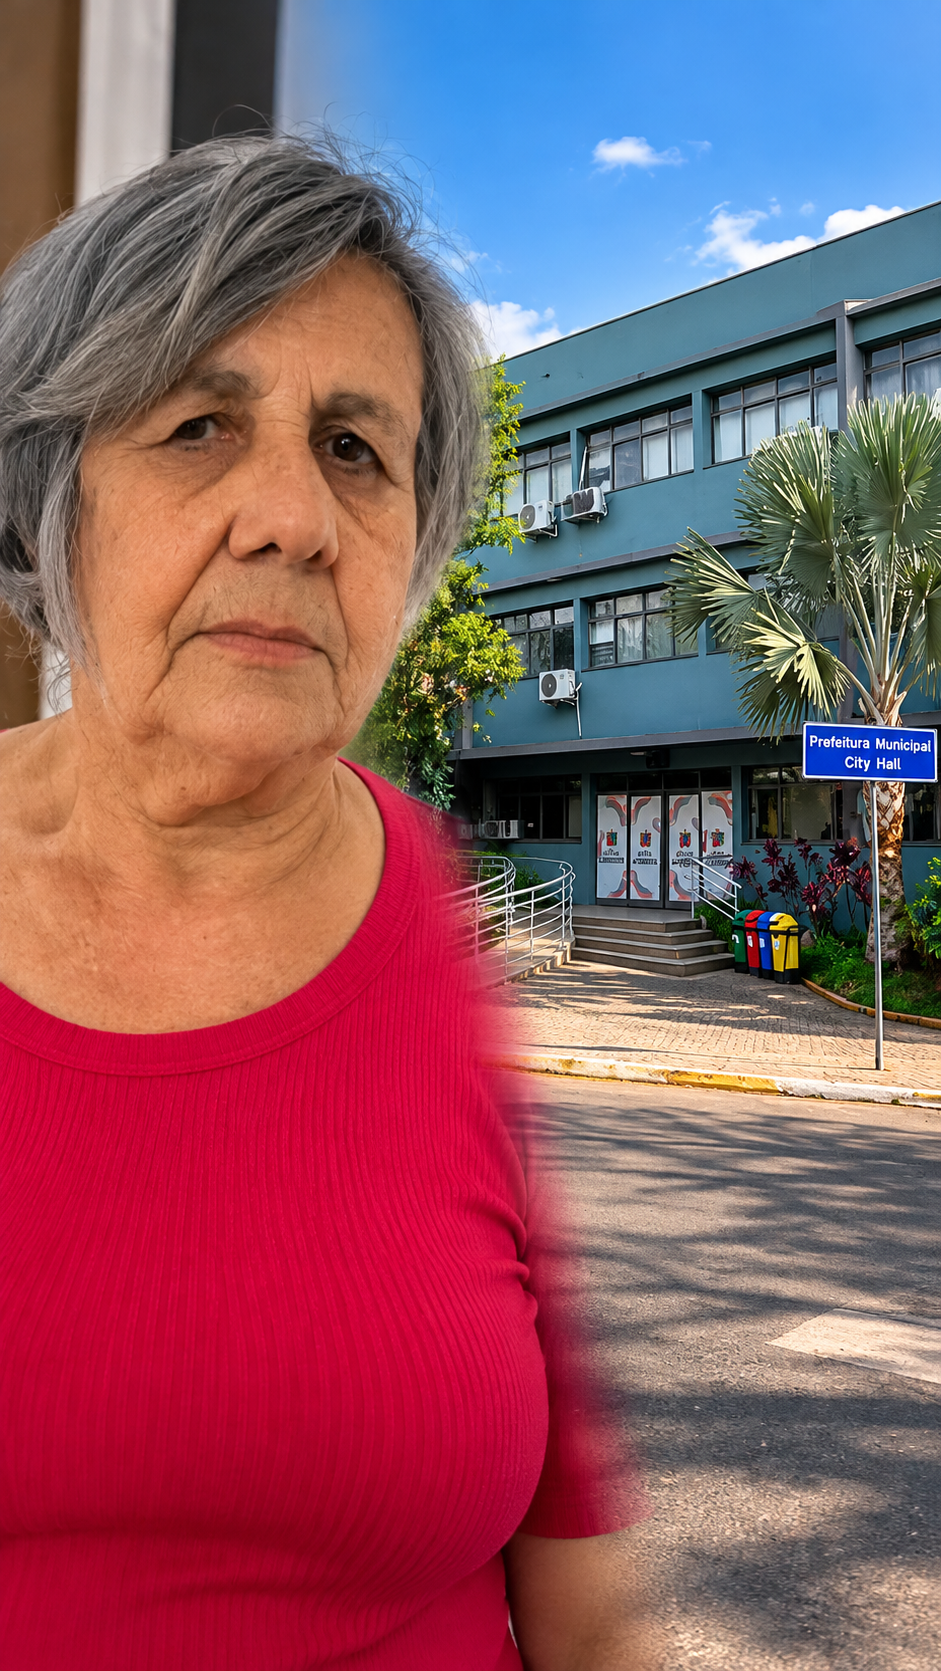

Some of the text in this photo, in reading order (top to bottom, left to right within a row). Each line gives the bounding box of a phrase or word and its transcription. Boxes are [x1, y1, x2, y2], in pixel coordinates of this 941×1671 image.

[809, 735, 931, 754] Prefeitura Municipal
[844, 756, 901, 772] City Hall
